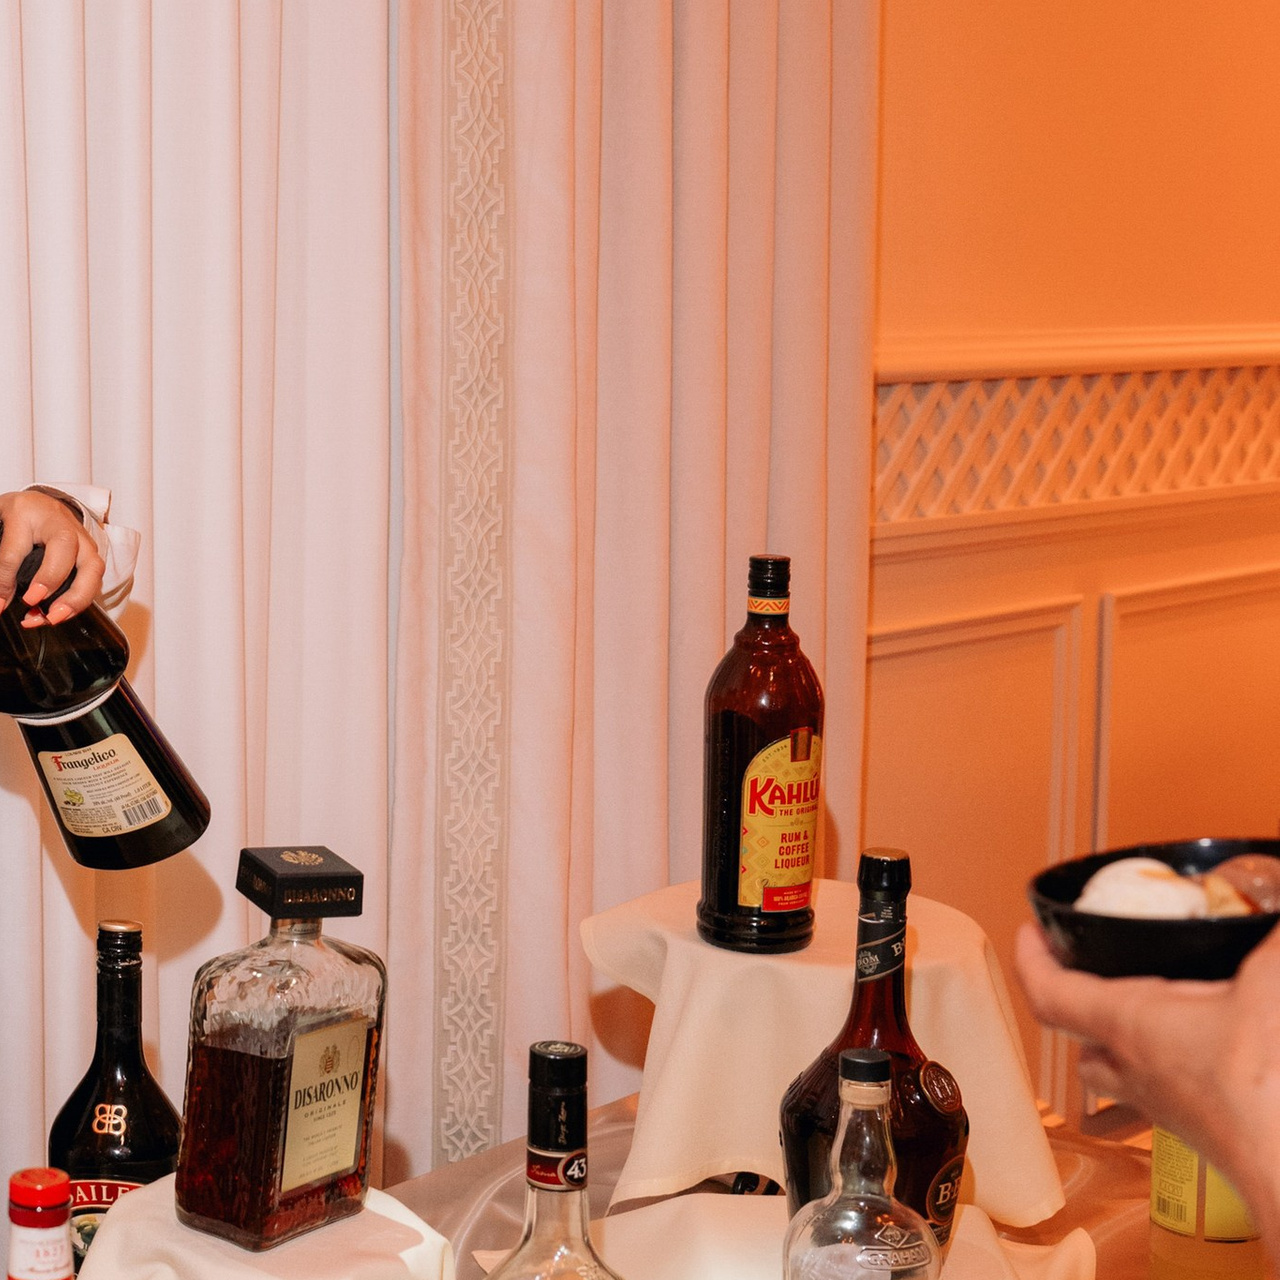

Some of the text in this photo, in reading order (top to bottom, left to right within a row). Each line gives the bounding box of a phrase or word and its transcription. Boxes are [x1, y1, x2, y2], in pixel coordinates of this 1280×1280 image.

[51, 748, 116, 772] Frangelico
[779, 808, 795, 816] THE
[781, 830, 809, 843] RUM &
[778, 842, 810, 856] COFFEE
[774, 855, 810, 870] LIQUEUR
[284, 887, 356, 904] DISARONNO
[294, 1070, 359, 1110] DISARONNO
[566, 1157, 587, 1179] 43
[68, 1184, 130, 1205] AILE
